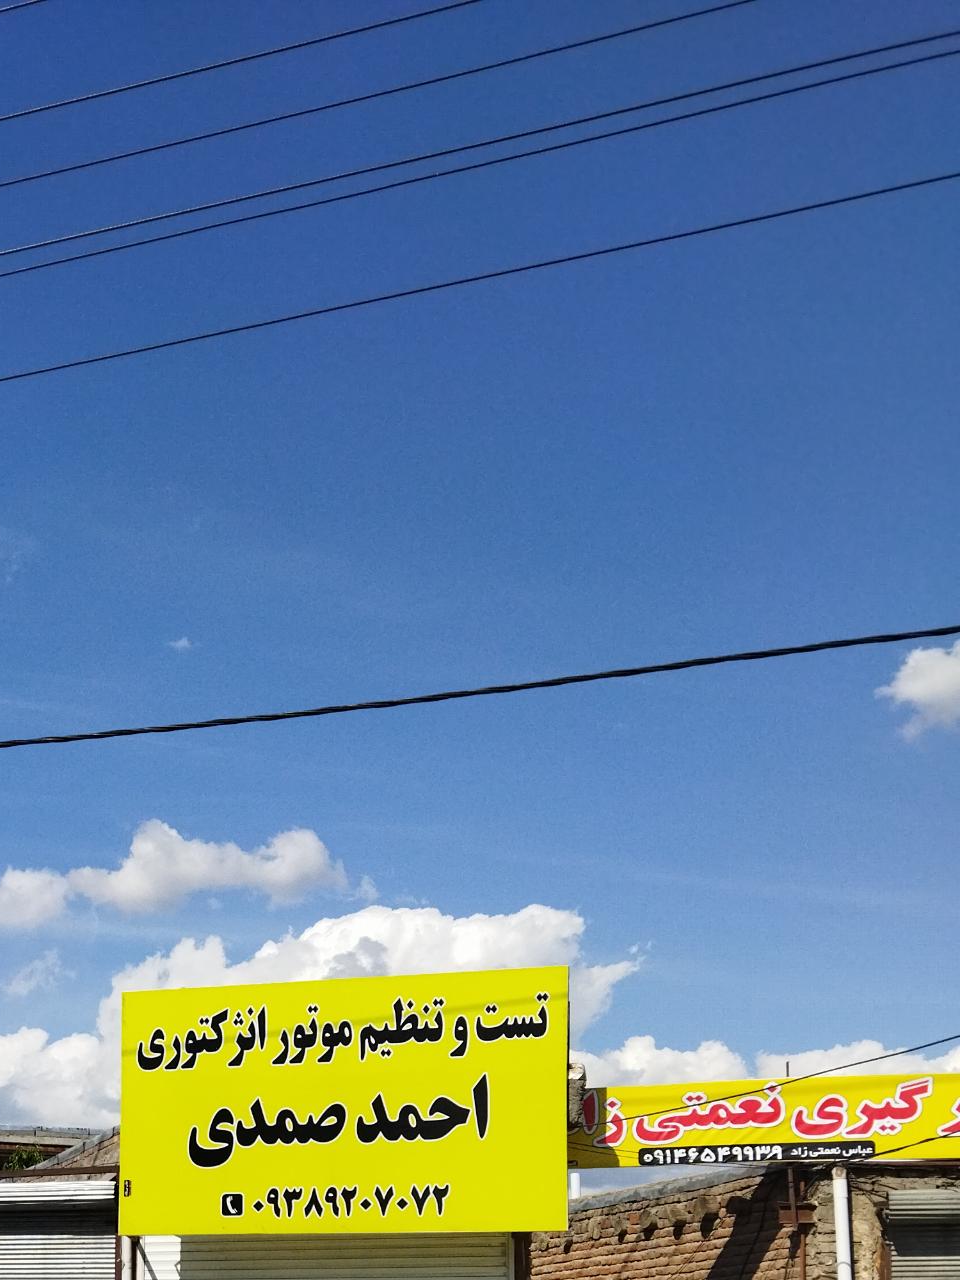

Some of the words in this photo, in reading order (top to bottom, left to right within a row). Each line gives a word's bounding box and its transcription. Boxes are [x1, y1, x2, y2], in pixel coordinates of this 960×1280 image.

[137, 1005, 267, 1071] انژکتوری
[271, 1004, 354, 1066] موتور
[359, 997, 445, 1062] تنظیم
[449, 1015, 470, 1058] و
[476, 992, 549, 1042] تست
[188, 1097, 347, 1168] صمدی
[356, 1073, 490, 1144] احمد
[634, 1082, 786, 1145] نعمتی
[792, 1076, 935, 1141] گیری
[642, 1145, 784, 1165] ۰۹۱۴۶۵۴۹۹۳۹
[808, 1146, 841, 1158] نعمتی
[842, 1145, 874, 1157] عباس
[252, 1183, 450, 1219] ۰۹۳۸۹۲۰۷۰۷۲
